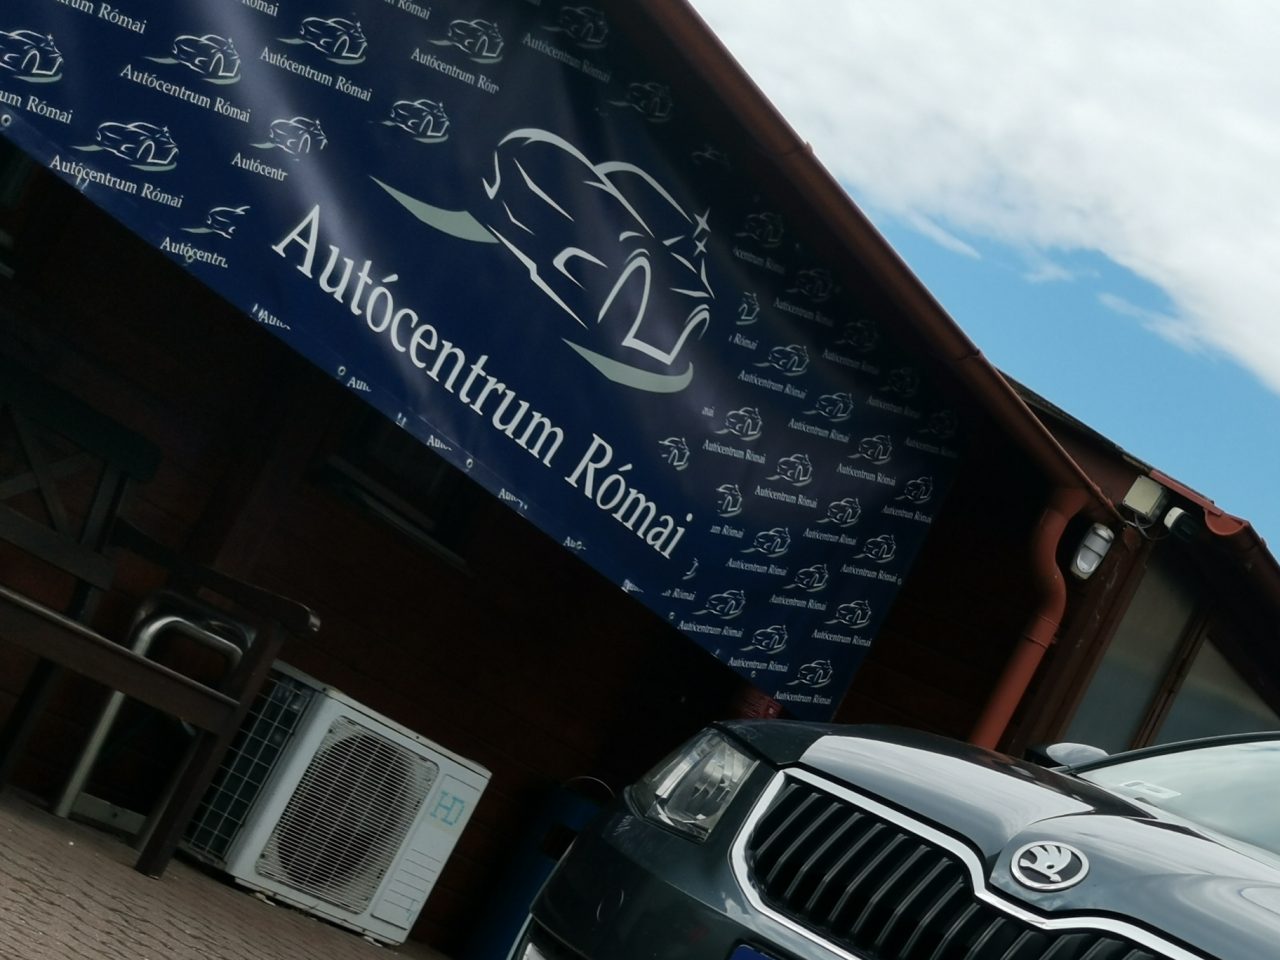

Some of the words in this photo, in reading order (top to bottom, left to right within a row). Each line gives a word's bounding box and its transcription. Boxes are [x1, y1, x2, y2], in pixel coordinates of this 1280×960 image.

[98, 2, 147, 34] Római
[119, 63, 212, 109] Autócentrum
[213, 96, 251, 123] Római
[259, 46, 333, 87] Autócentrum
[335, 75, 373, 102] Római
[410, 47, 476, 86] Autócentrum
[26, 95, 74, 125] Római
[49, 154, 138, 195] Autócentrum
[140, 182, 185, 209] Római
[271, 203, 566, 468] Autócentrum
[564, 432, 694, 560] Római
